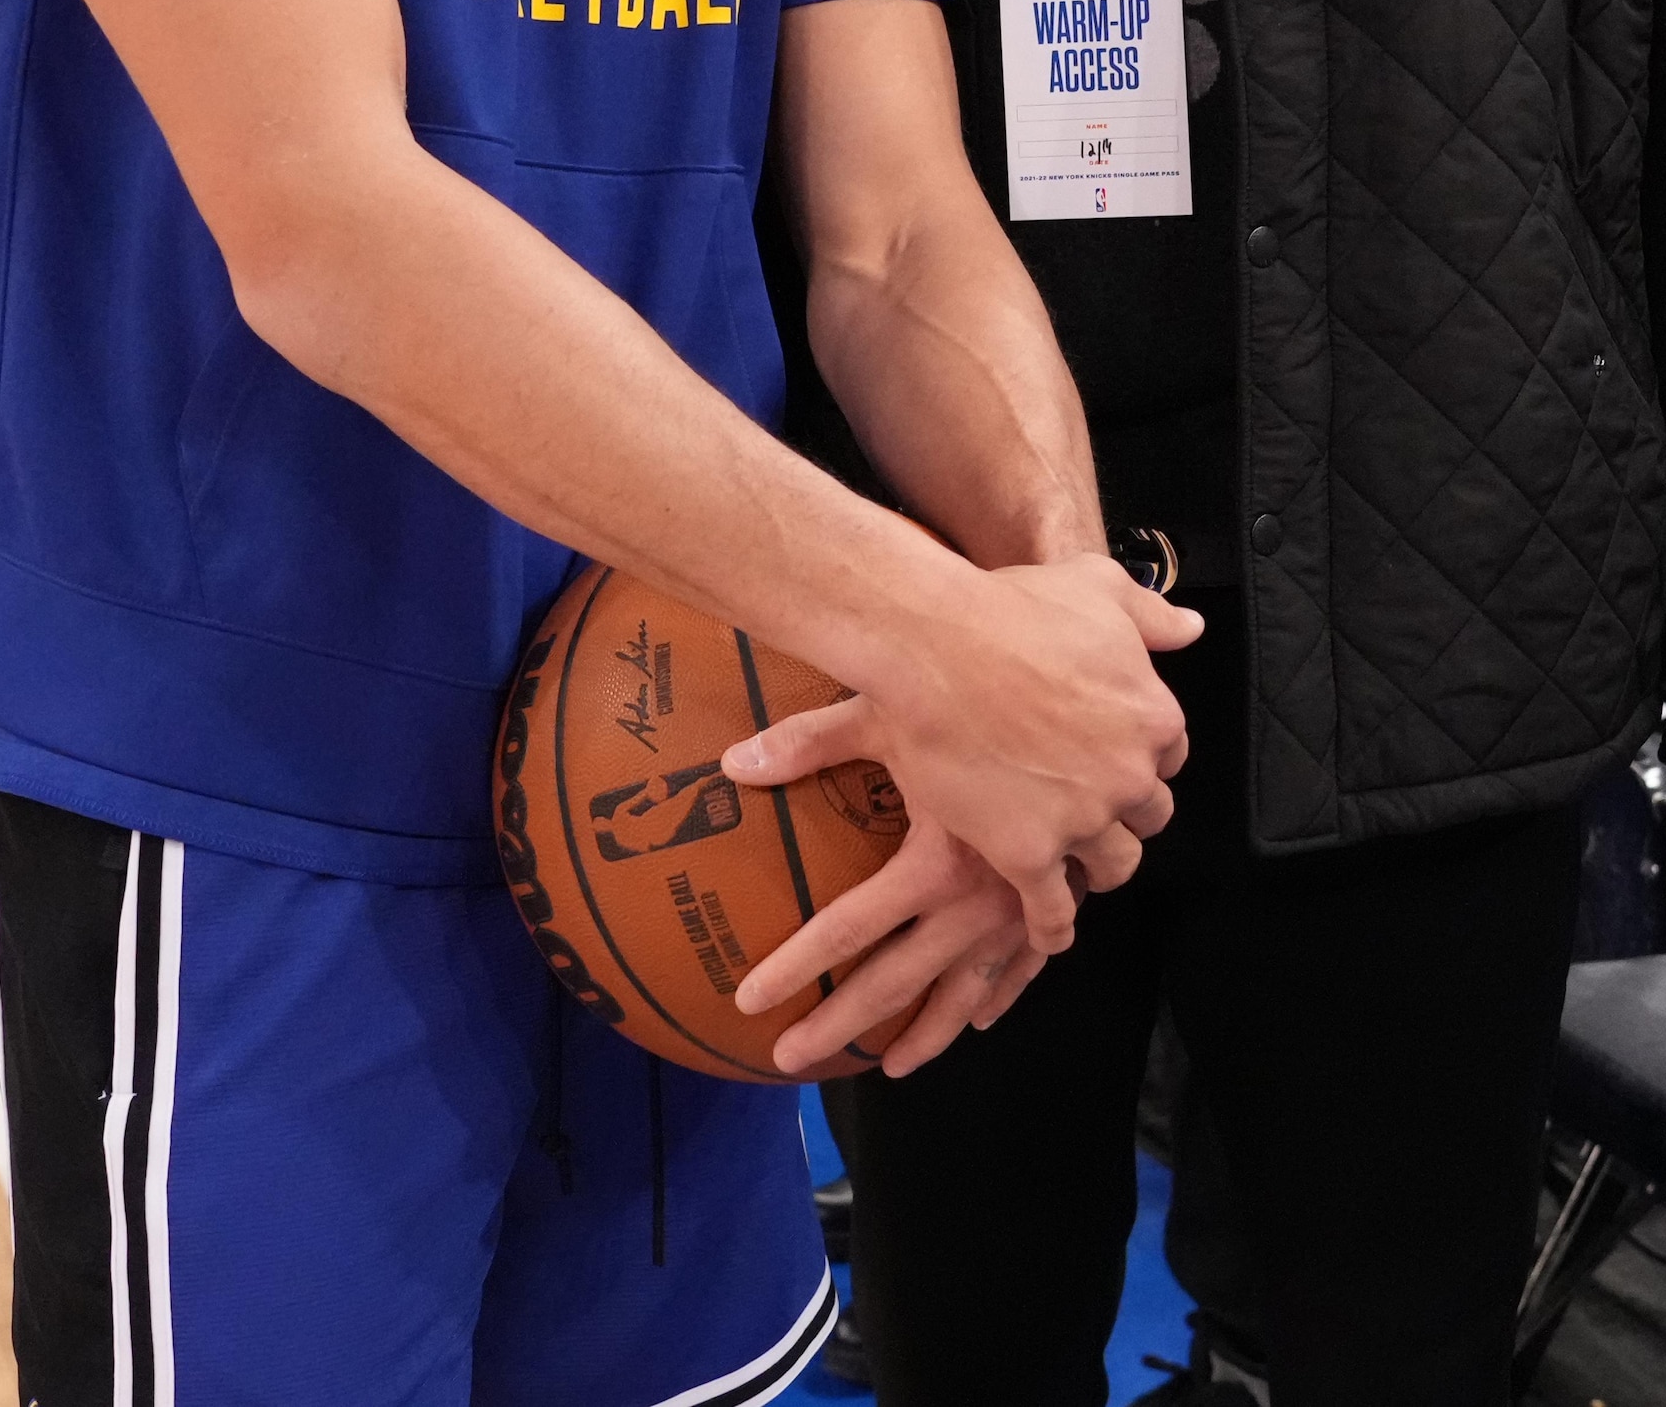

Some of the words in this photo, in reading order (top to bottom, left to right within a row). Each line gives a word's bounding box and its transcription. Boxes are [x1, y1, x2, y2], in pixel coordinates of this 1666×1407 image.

[1049, 47, 1140, 93] ACCESS
[654, 641, 673, 716] COMMISSIONER
[704, 786, 734, 825] NBA
[666, 870, 696, 906] BALL
[678, 905, 711, 944] GAME
[701, 890, 730, 931] LEATHER
[695, 942, 737, 995] OFFICIAL
[717, 930, 749, 968] GENUINE
